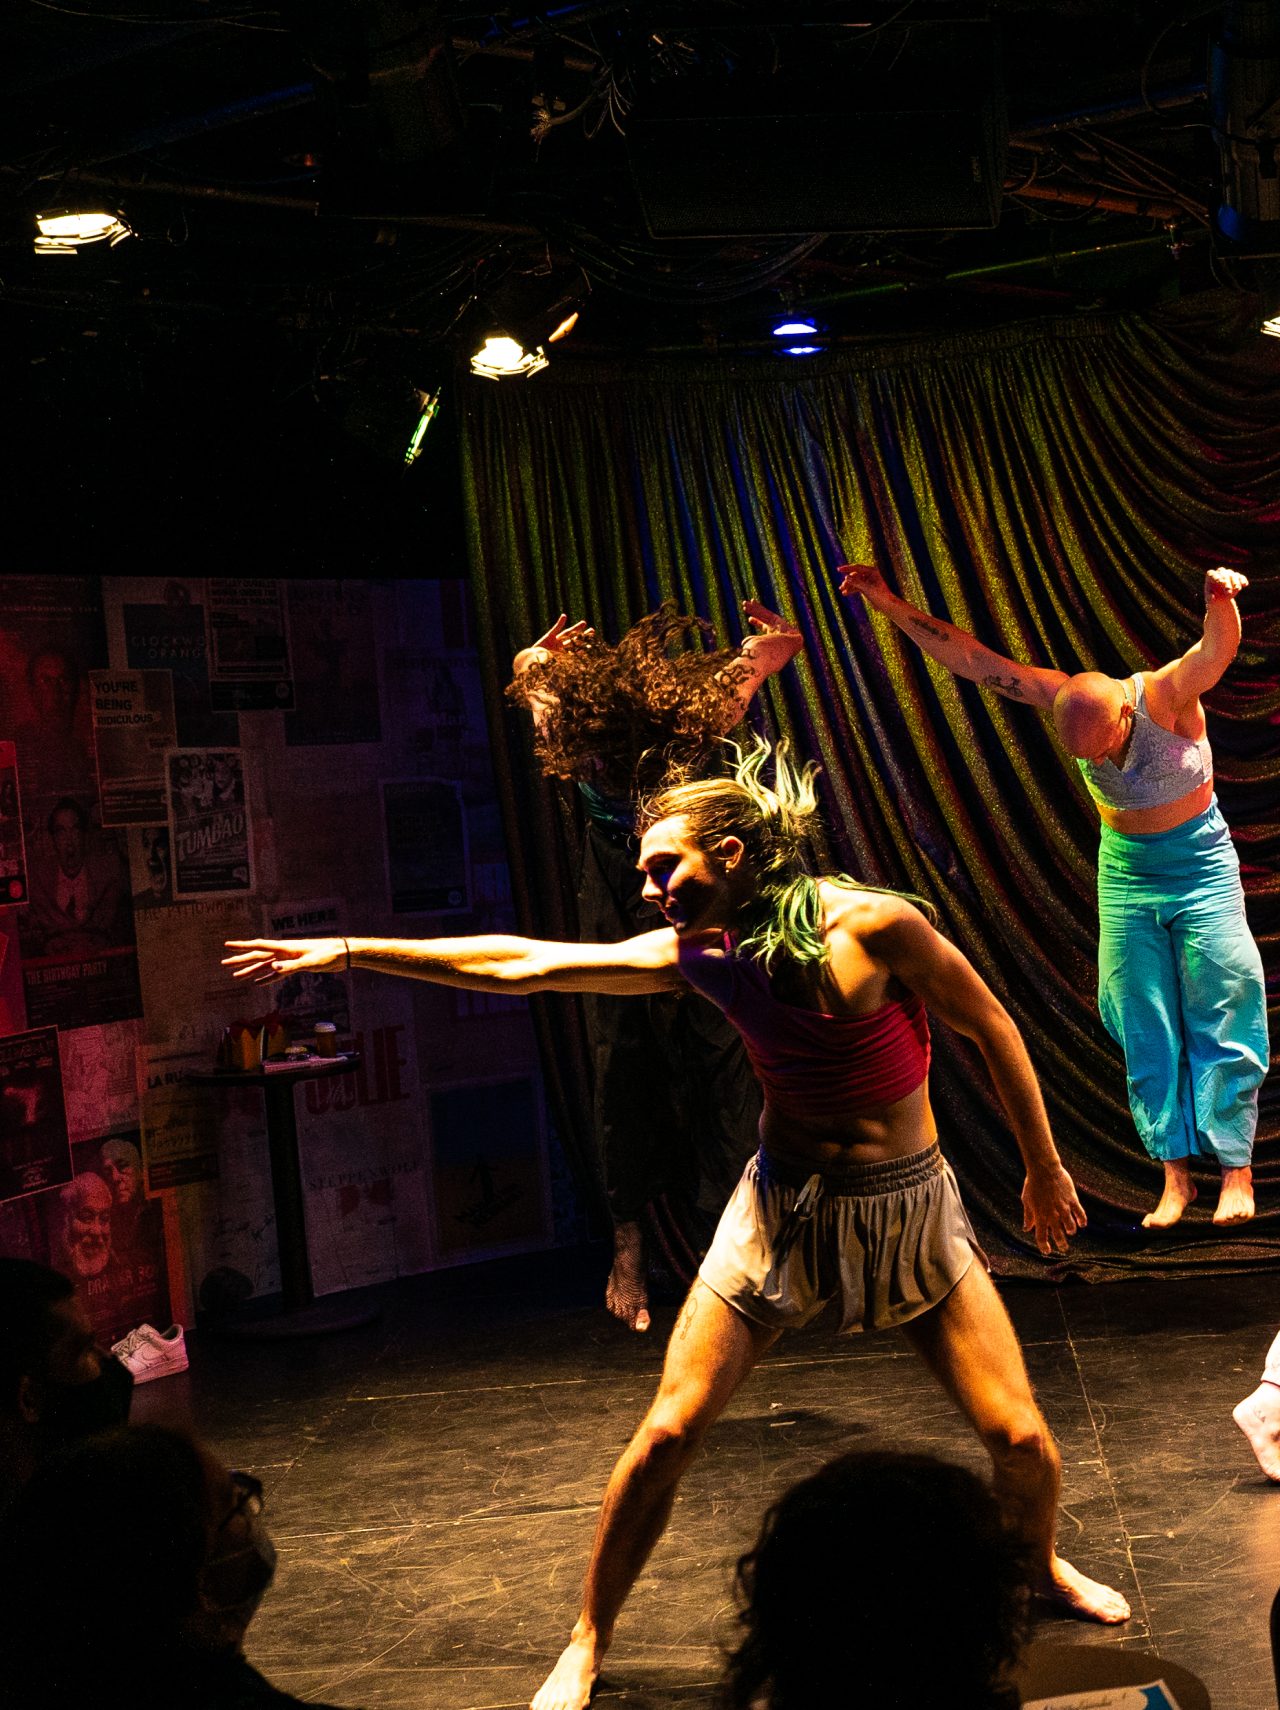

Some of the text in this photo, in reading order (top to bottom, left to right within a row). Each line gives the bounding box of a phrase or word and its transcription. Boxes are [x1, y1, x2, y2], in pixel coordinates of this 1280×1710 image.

[95, 680, 138, 694] YOU'RE
[96, 699, 132, 711] BEING
[97, 713, 154, 726] RIDICULOUS
[176, 813, 244, 862] TUMBAO
[271, 916, 295, 931] WE
[25, 970, 42, 985] THE
[147, 1075, 163, 1089] LA
